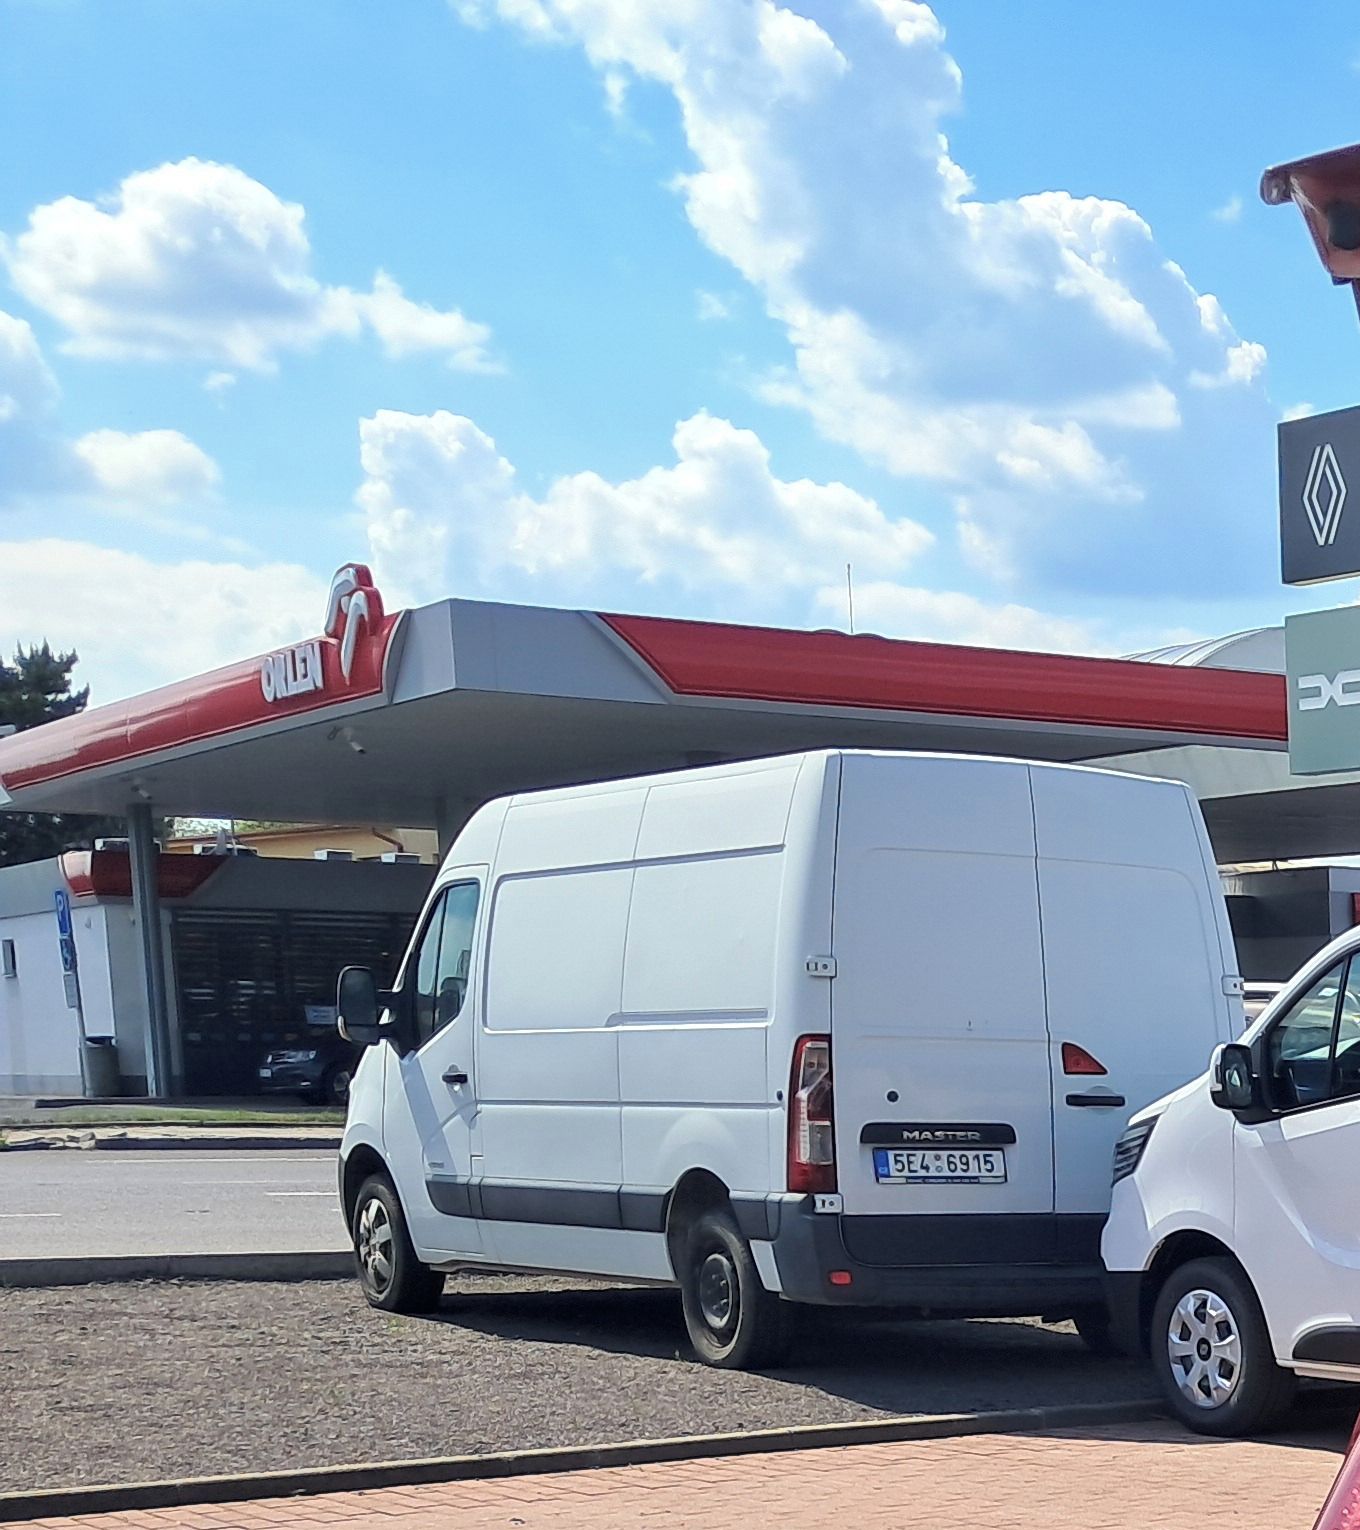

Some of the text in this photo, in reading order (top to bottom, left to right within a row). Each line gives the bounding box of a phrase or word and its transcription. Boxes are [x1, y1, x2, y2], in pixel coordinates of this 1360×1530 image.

[261, 642, 323, 703] ORLEN
[902, 1130, 982, 1141] MASTER
[893, 1153, 930, 1173] 5E4
[946, 1153, 995, 1173] 6915
